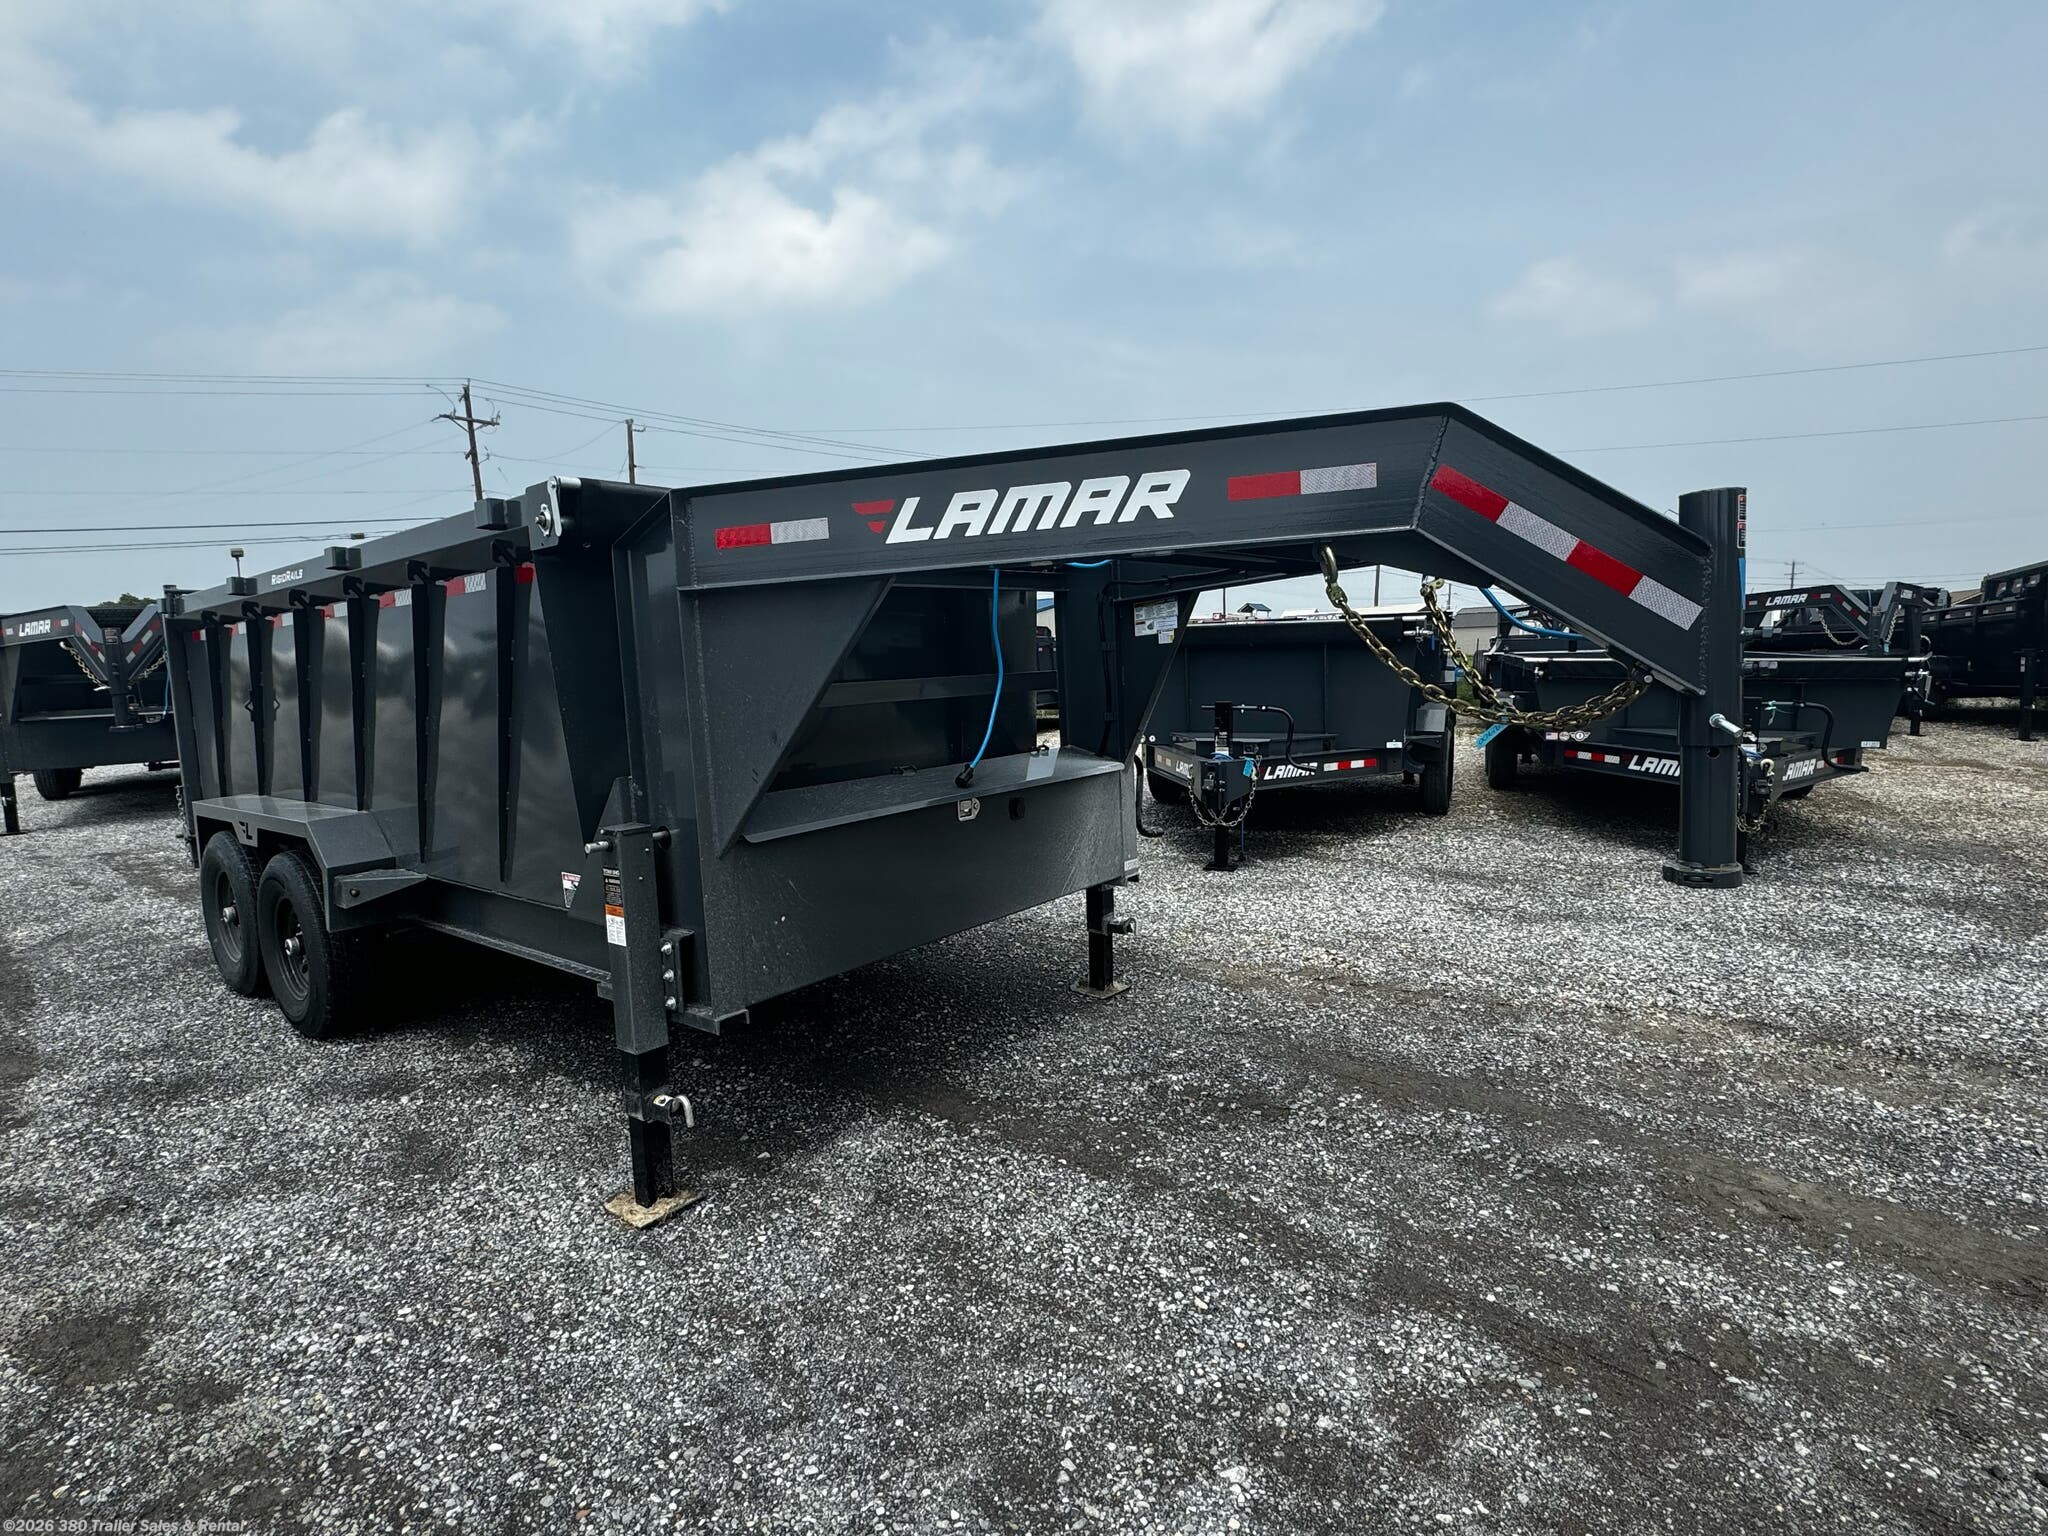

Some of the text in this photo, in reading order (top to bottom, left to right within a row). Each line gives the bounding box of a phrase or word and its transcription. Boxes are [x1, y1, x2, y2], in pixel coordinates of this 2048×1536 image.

[885, 469, 1191, 544] LAMAR
[1765, 594, 1808, 606] LAMAR
[19, 619, 50, 636] LAMAR
[1628, 755, 1680, 776] LAM
